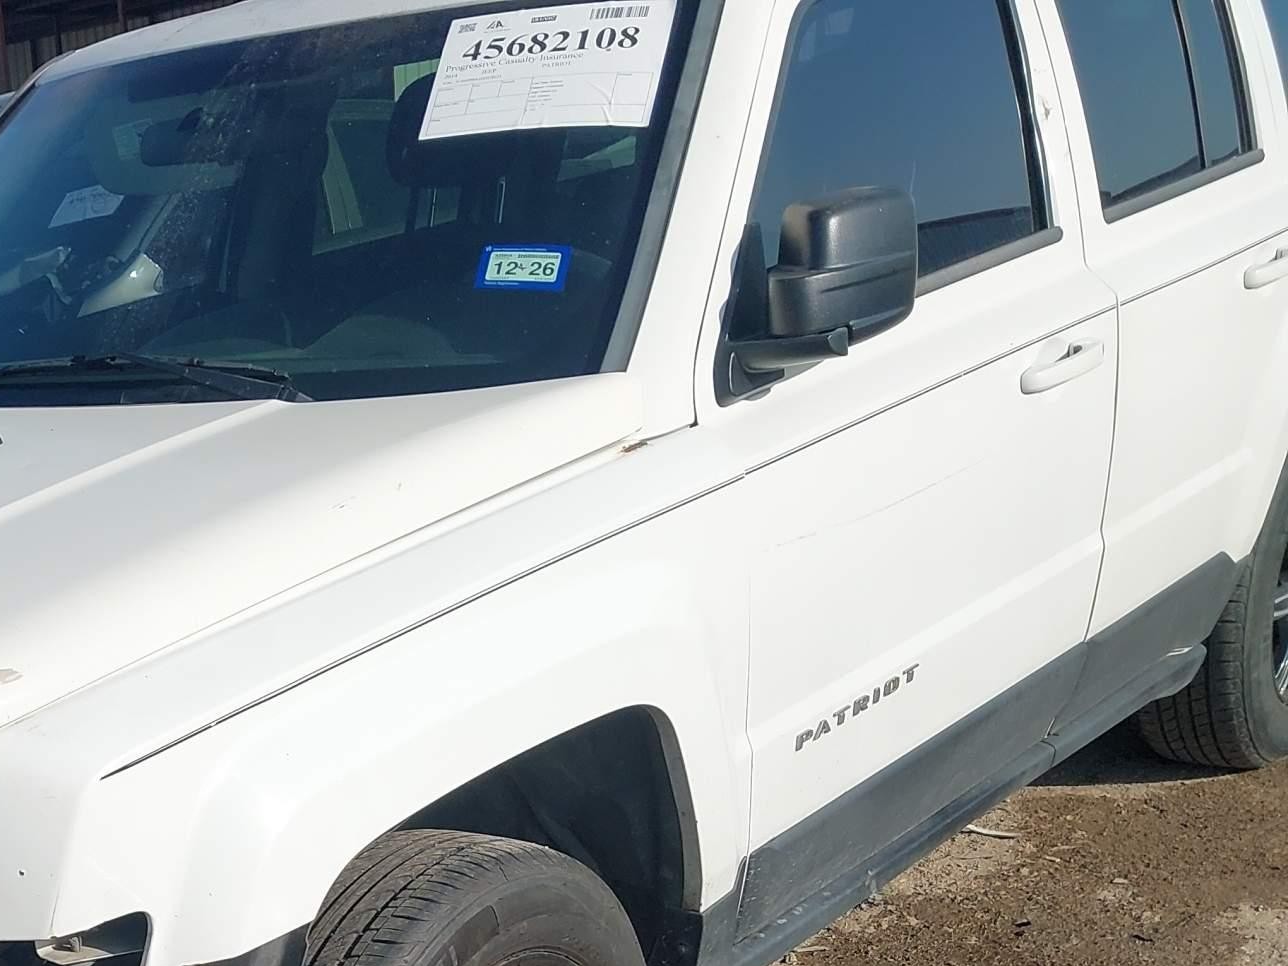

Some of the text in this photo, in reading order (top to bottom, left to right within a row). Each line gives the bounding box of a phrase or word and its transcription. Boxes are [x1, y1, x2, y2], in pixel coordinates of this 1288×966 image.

[462, 26, 640, 61] 45682108
[445, 51, 584, 73] Progressive Casualty Insurance
[795, 663, 920, 752] PATRIOT
